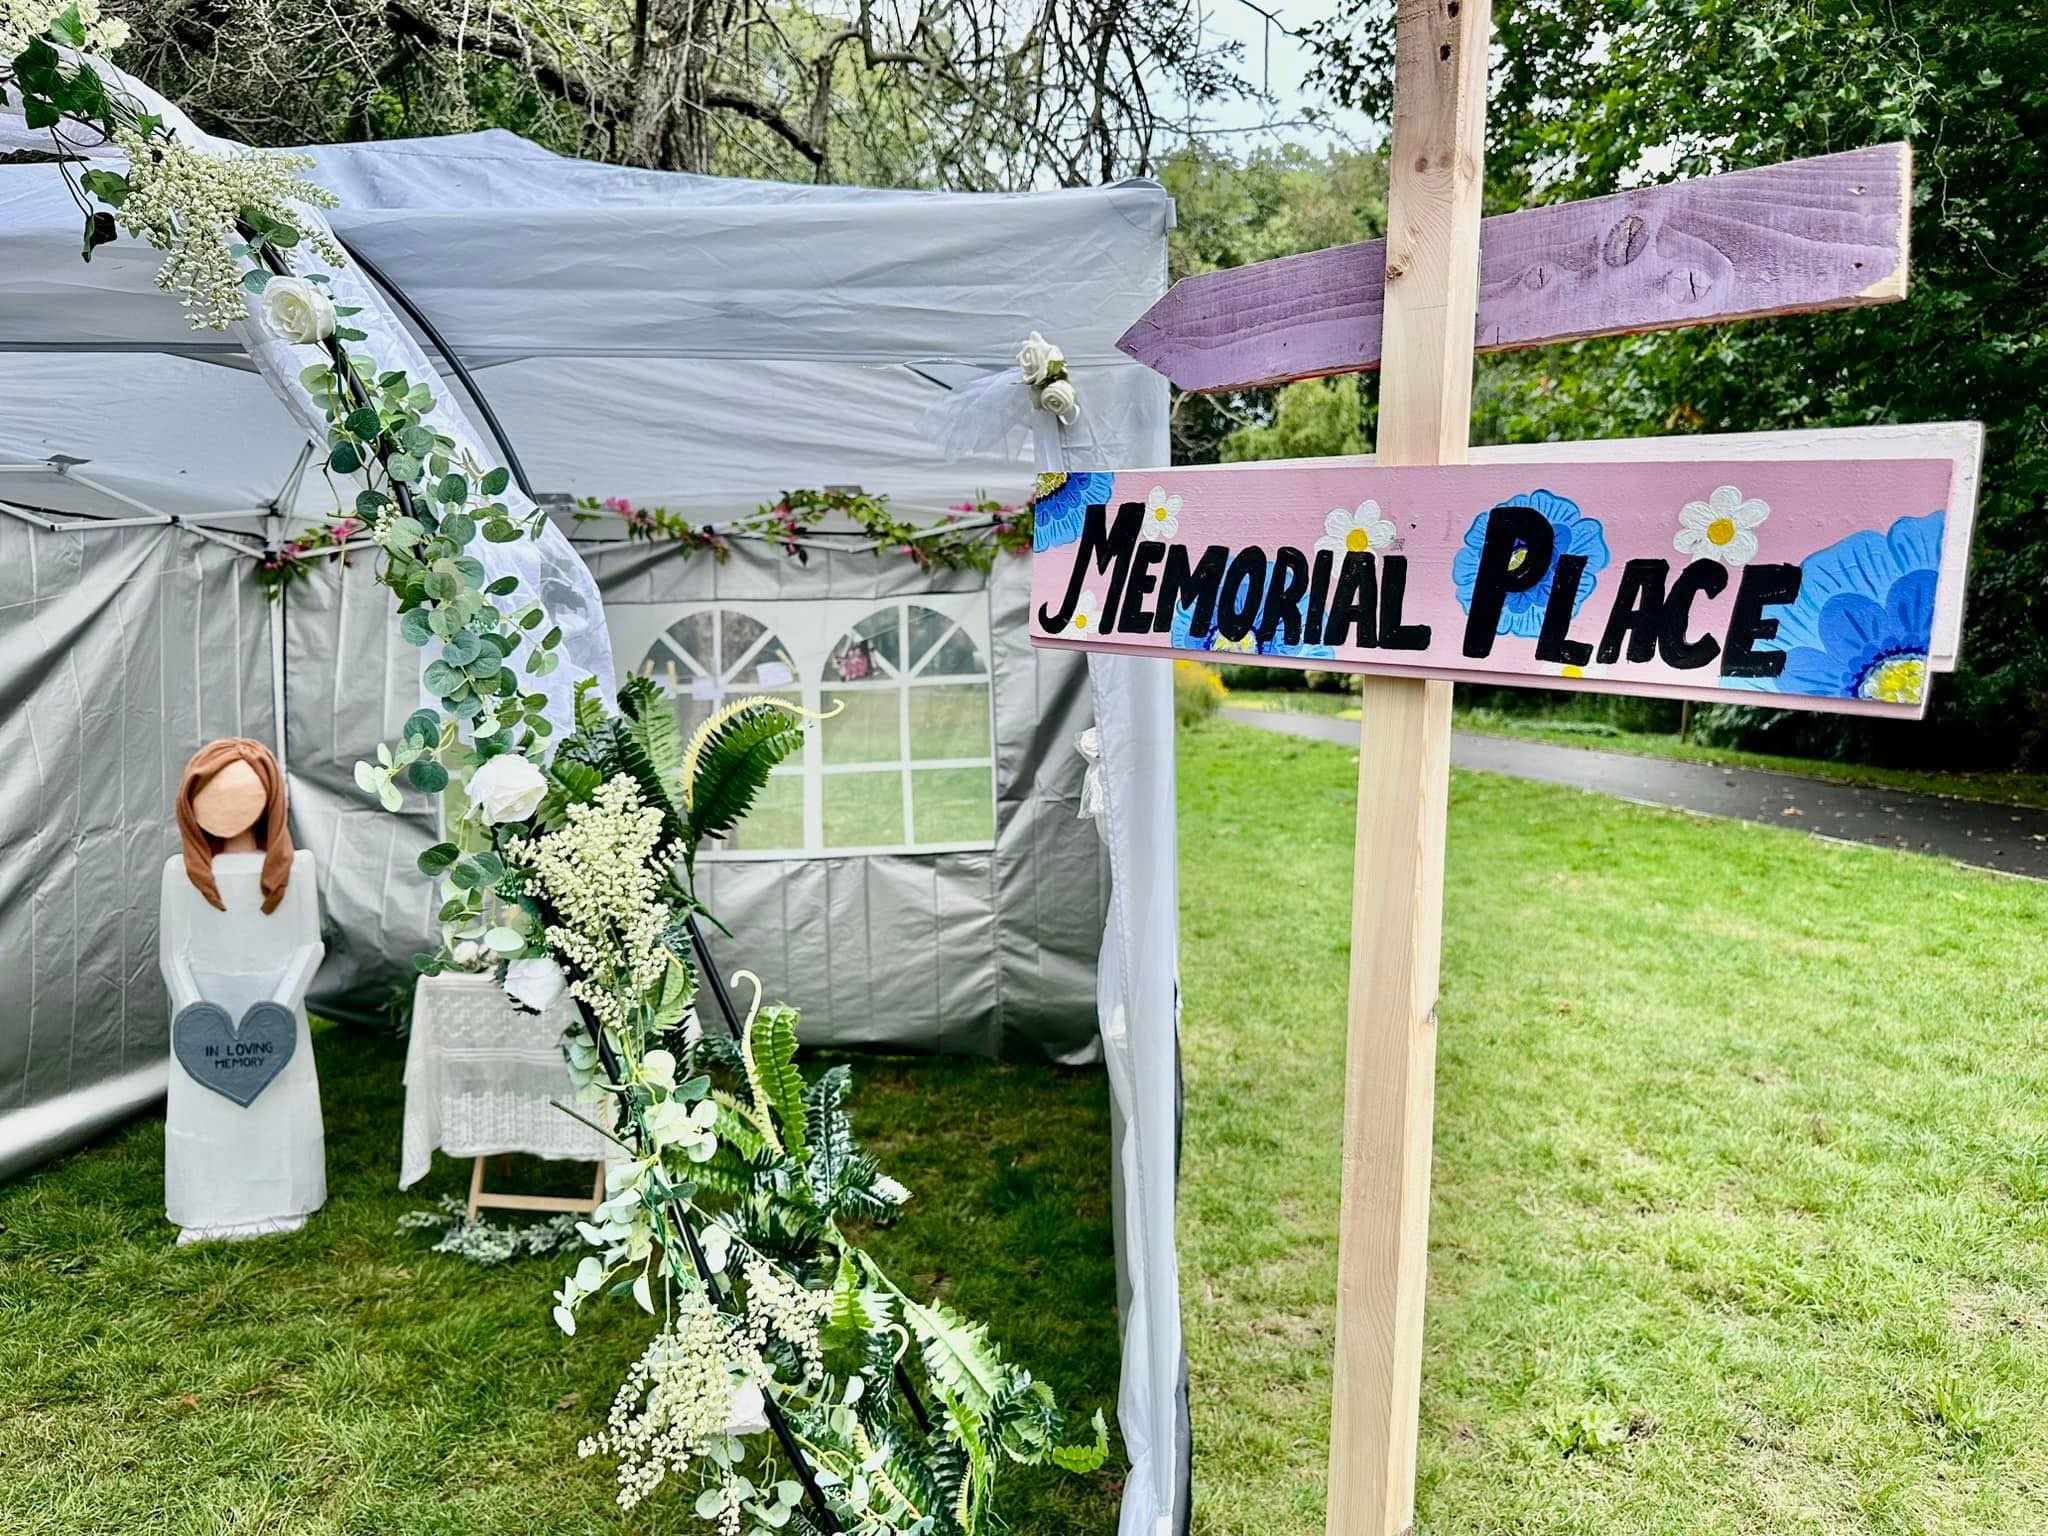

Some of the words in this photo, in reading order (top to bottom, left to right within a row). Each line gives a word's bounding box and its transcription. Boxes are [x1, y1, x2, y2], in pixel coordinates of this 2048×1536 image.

[1038, 502, 1431, 650] MEMORIAL
[1463, 506, 1802, 677] PLACE
[204, 1045, 219, 1056] IN
[226, 1041, 273, 1056] LOVING
[214, 1057, 265, 1069] MEMORY
